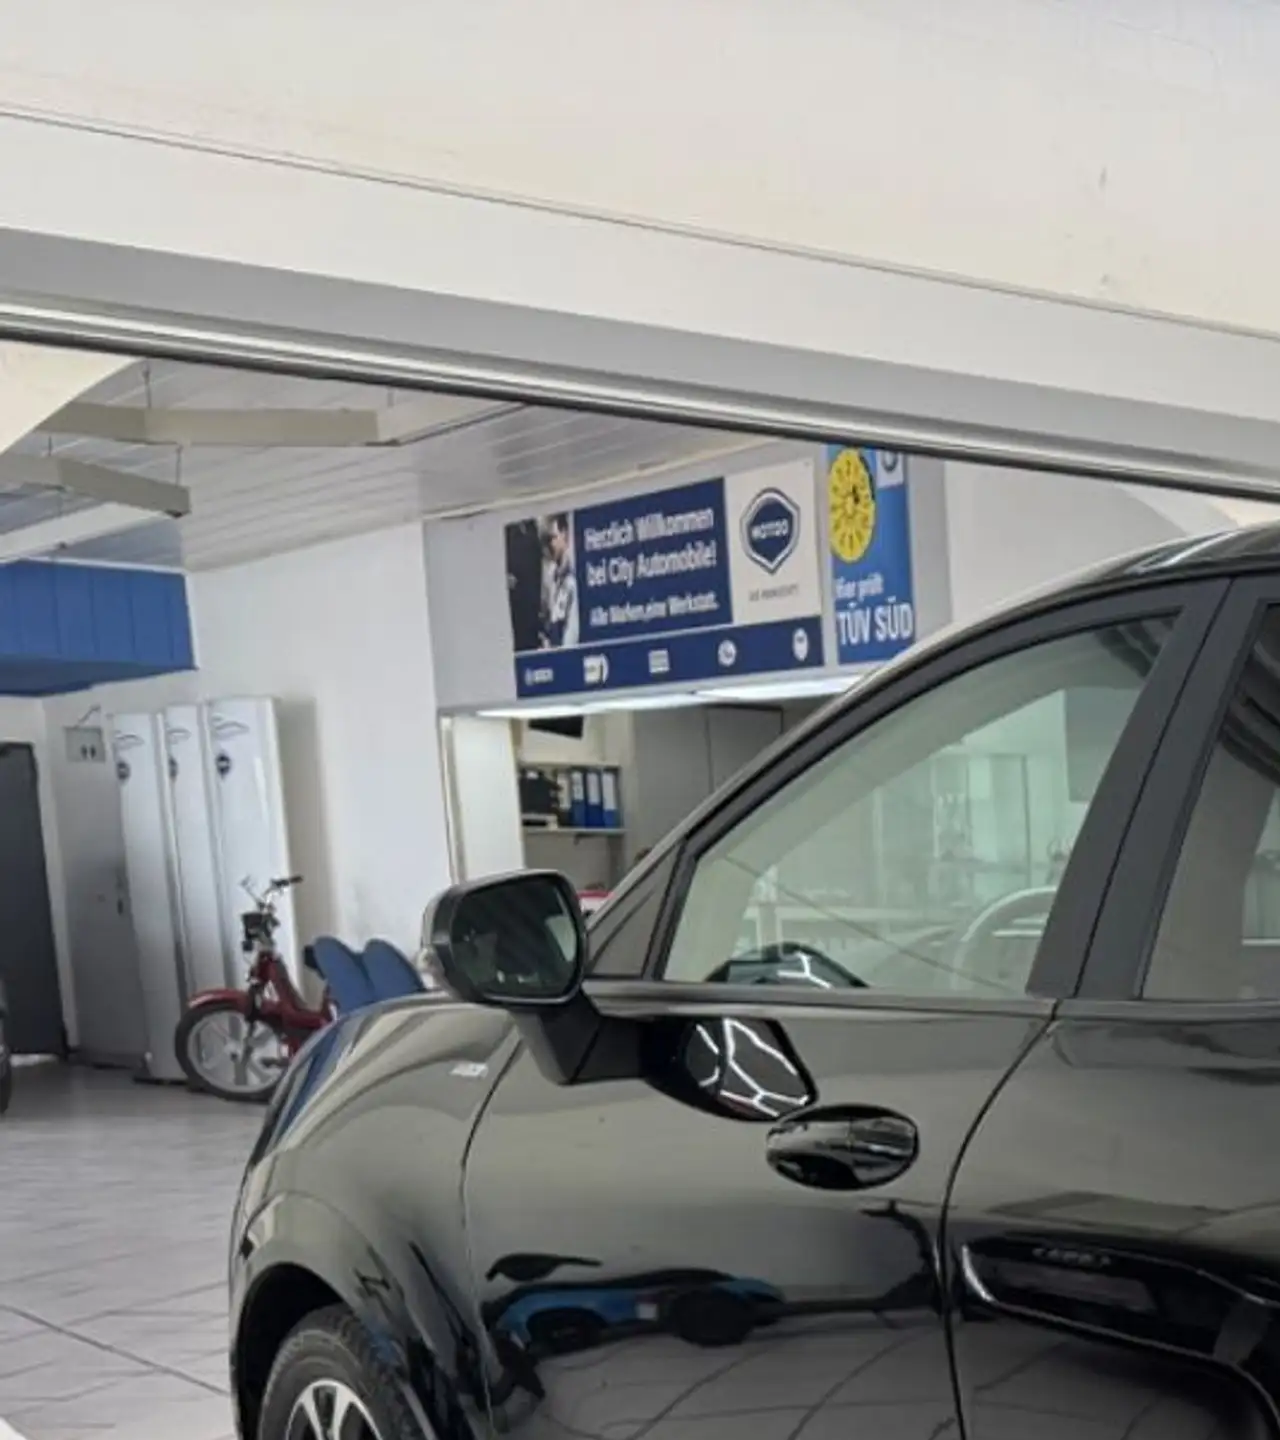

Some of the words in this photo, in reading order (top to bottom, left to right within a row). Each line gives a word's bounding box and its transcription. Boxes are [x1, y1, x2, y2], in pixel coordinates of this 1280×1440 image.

[608, 555, 634, 588] City
[838, 602, 870, 646] TÜV
[875, 596, 914, 643] SÜD
